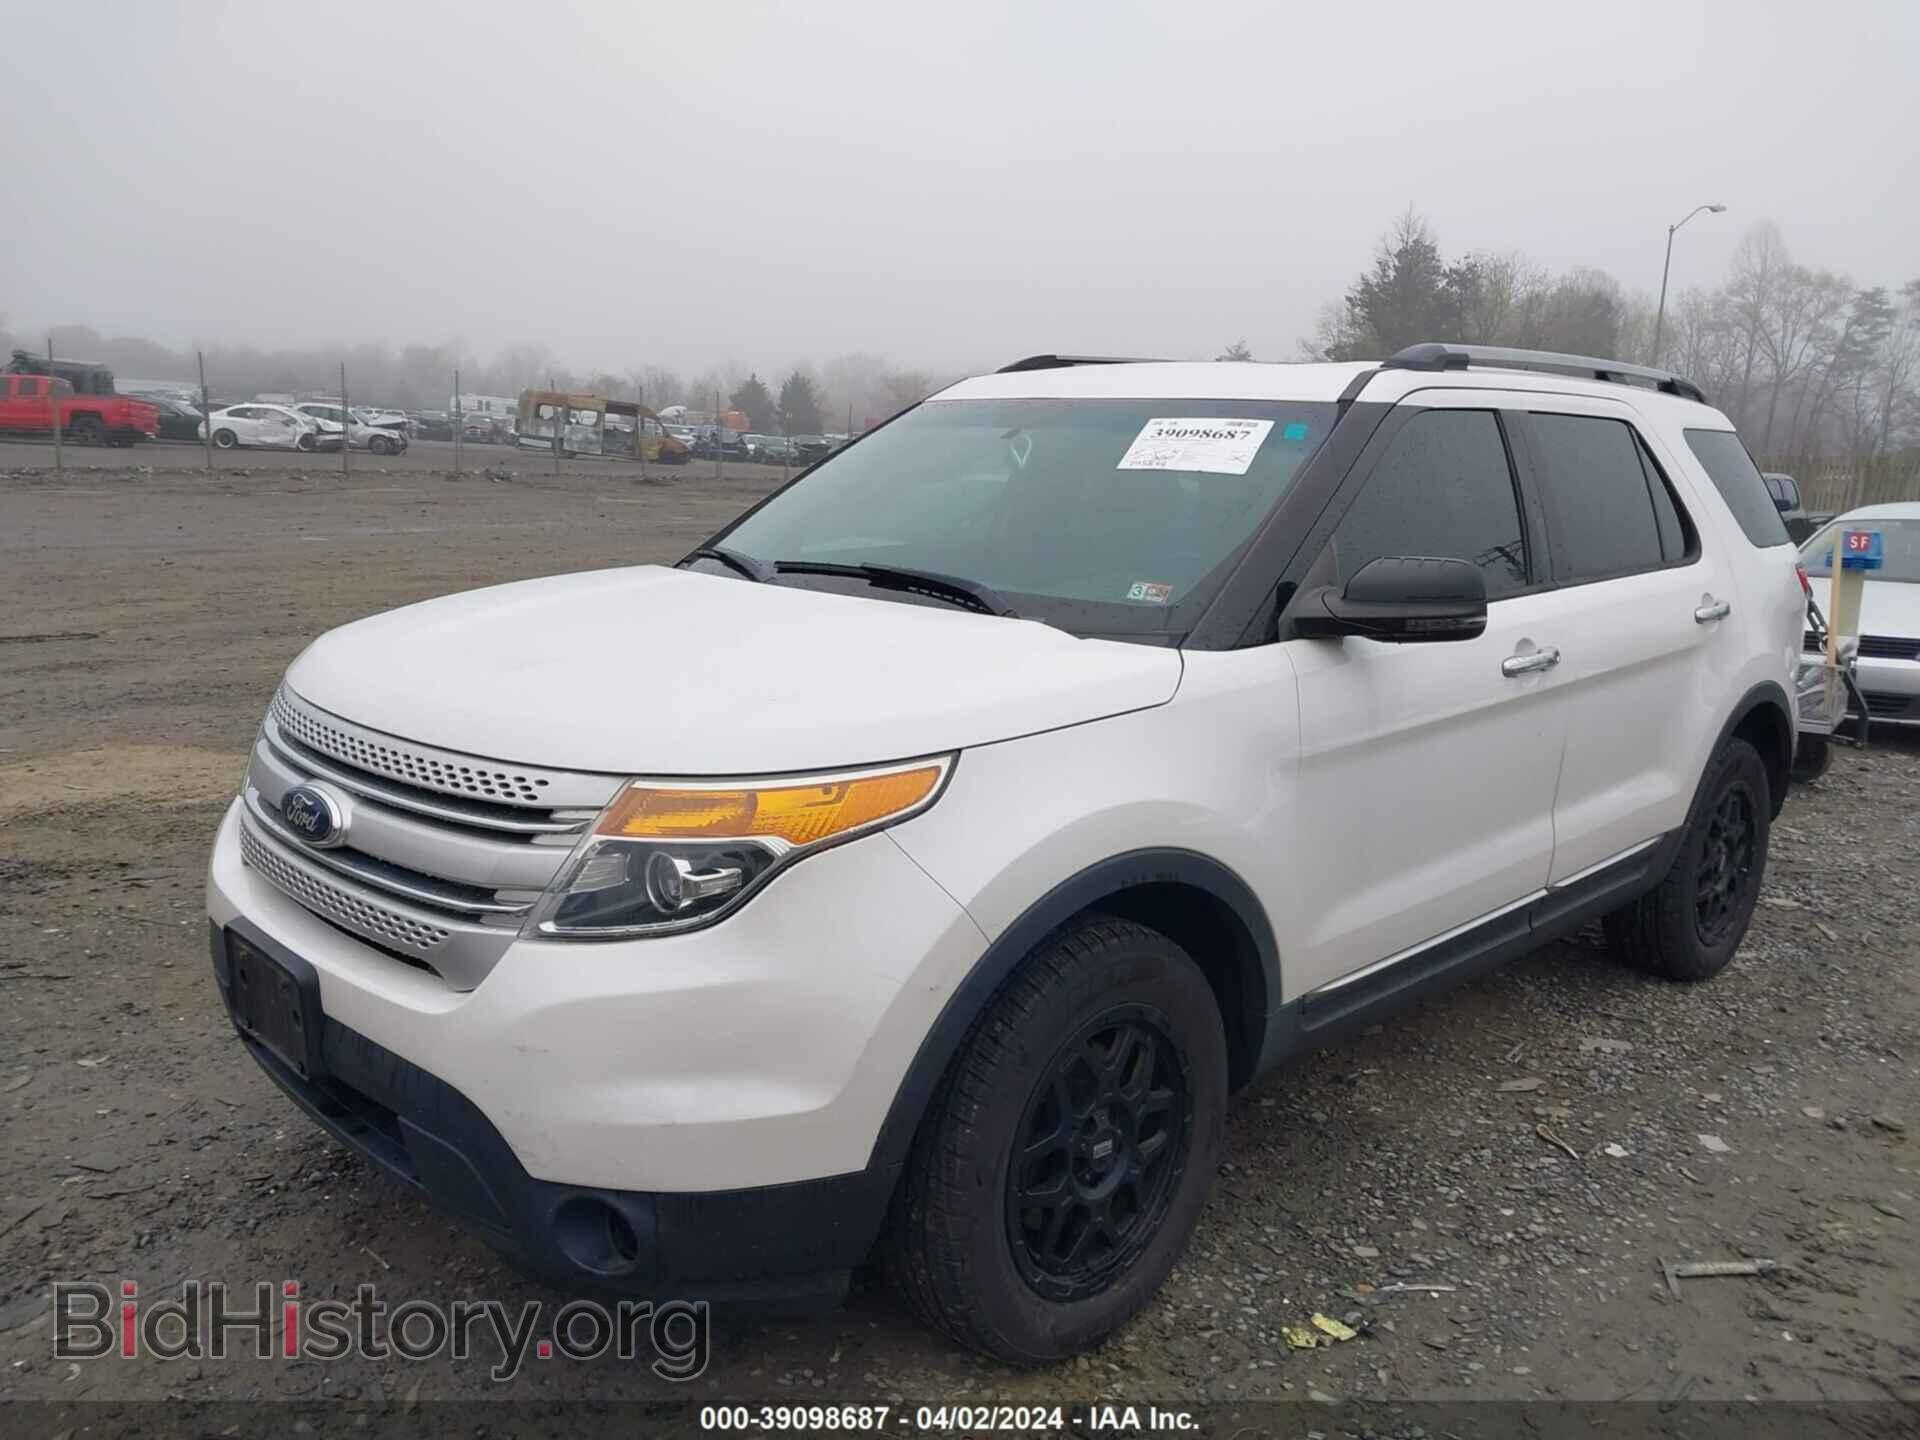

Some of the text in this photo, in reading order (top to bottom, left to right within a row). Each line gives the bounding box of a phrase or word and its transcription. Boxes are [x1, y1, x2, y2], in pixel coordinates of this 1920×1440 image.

[1154, 428, 1251, 441] 39098687
[1849, 535, 1870, 549] SF
[286, 792, 321, 834] Ford
